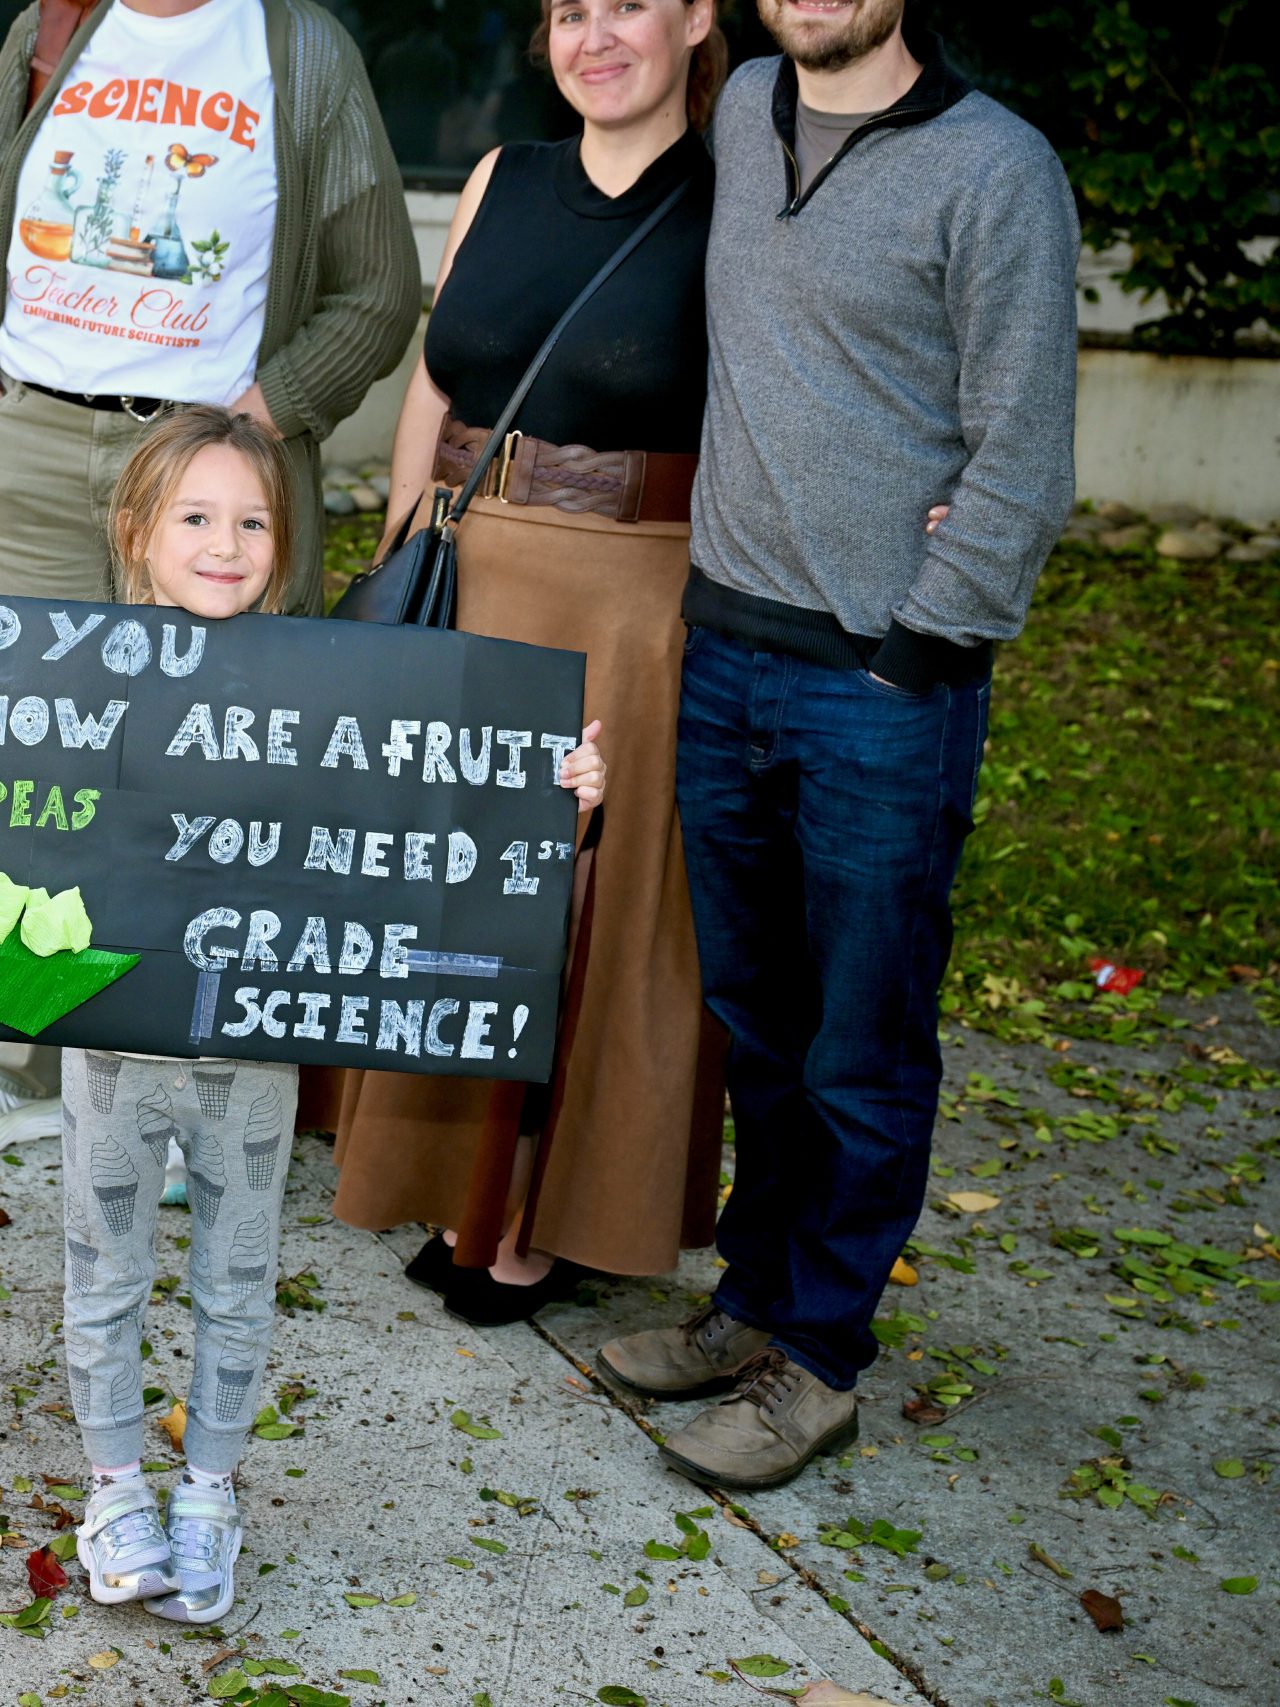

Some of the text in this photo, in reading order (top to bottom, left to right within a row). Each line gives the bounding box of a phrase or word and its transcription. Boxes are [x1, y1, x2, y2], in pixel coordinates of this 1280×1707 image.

[53, 78, 260, 153] SCIENCE
[82, 320, 126, 338] FUTURE
[128, 329, 200, 348] SCIENTISTS
[130, 286, 211, 332] Club
[41, 610, 206, 677] YOU
[165, 703, 576, 788] ARE A FRUIT
[164, 813, 282, 867] YOU
[304, 826, 478, 884] NEED
[183, 907, 418, 978] GRADE
[221, 986, 529, 1059] SCIENCE!
